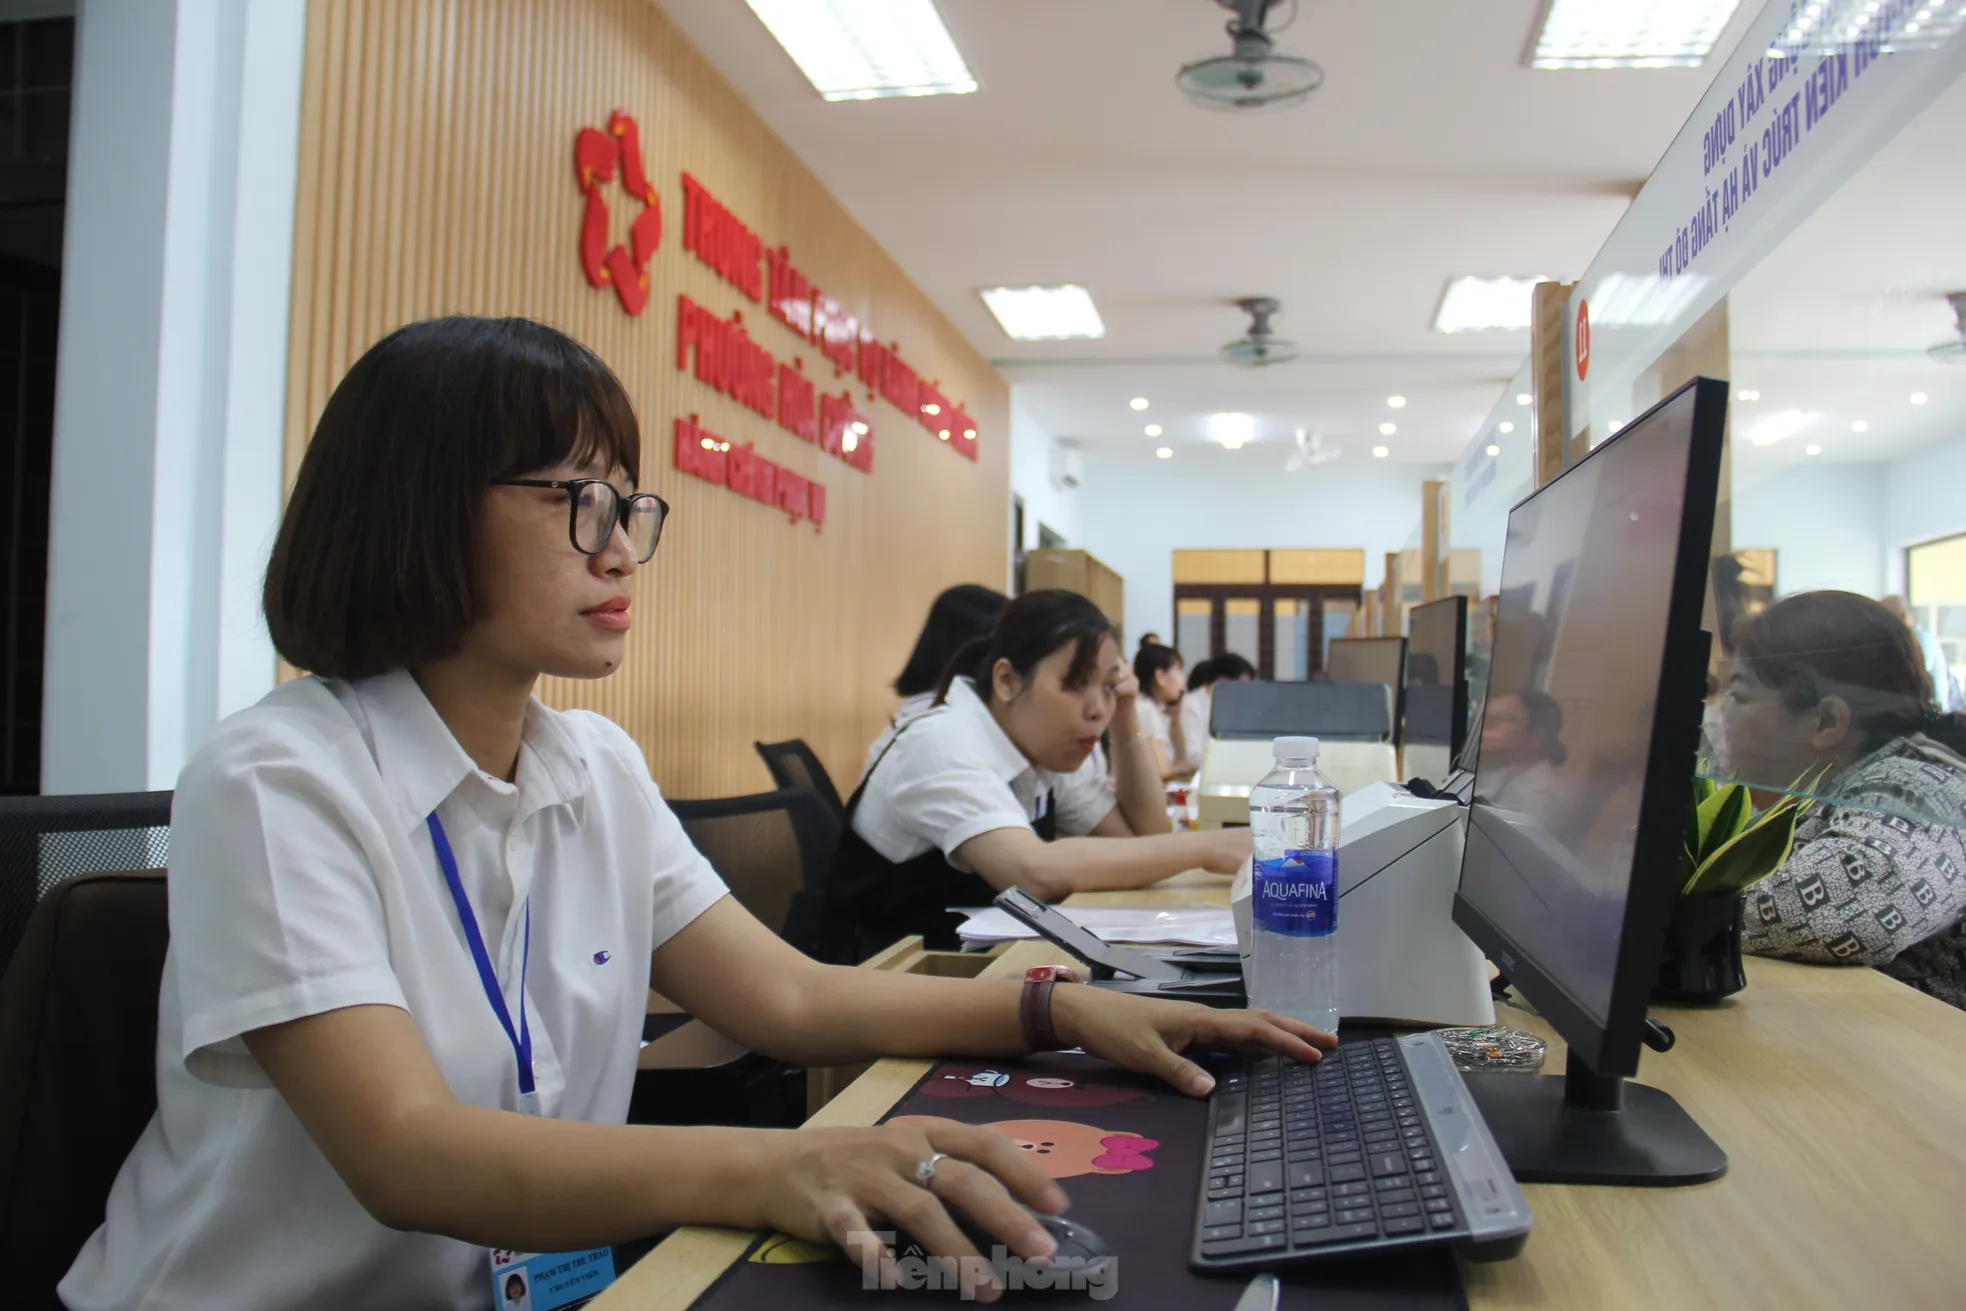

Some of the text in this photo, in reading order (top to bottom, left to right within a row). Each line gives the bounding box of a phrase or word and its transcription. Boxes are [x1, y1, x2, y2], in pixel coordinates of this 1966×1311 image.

[1262, 880, 1328, 901] AQUAFINA
[1801, 881, 1826, 908] B
[1915, 882, 1935, 906] B
[1759, 901, 1776, 922] B
[1880, 906, 1904, 930] B
[1831, 935, 1861, 958] B
